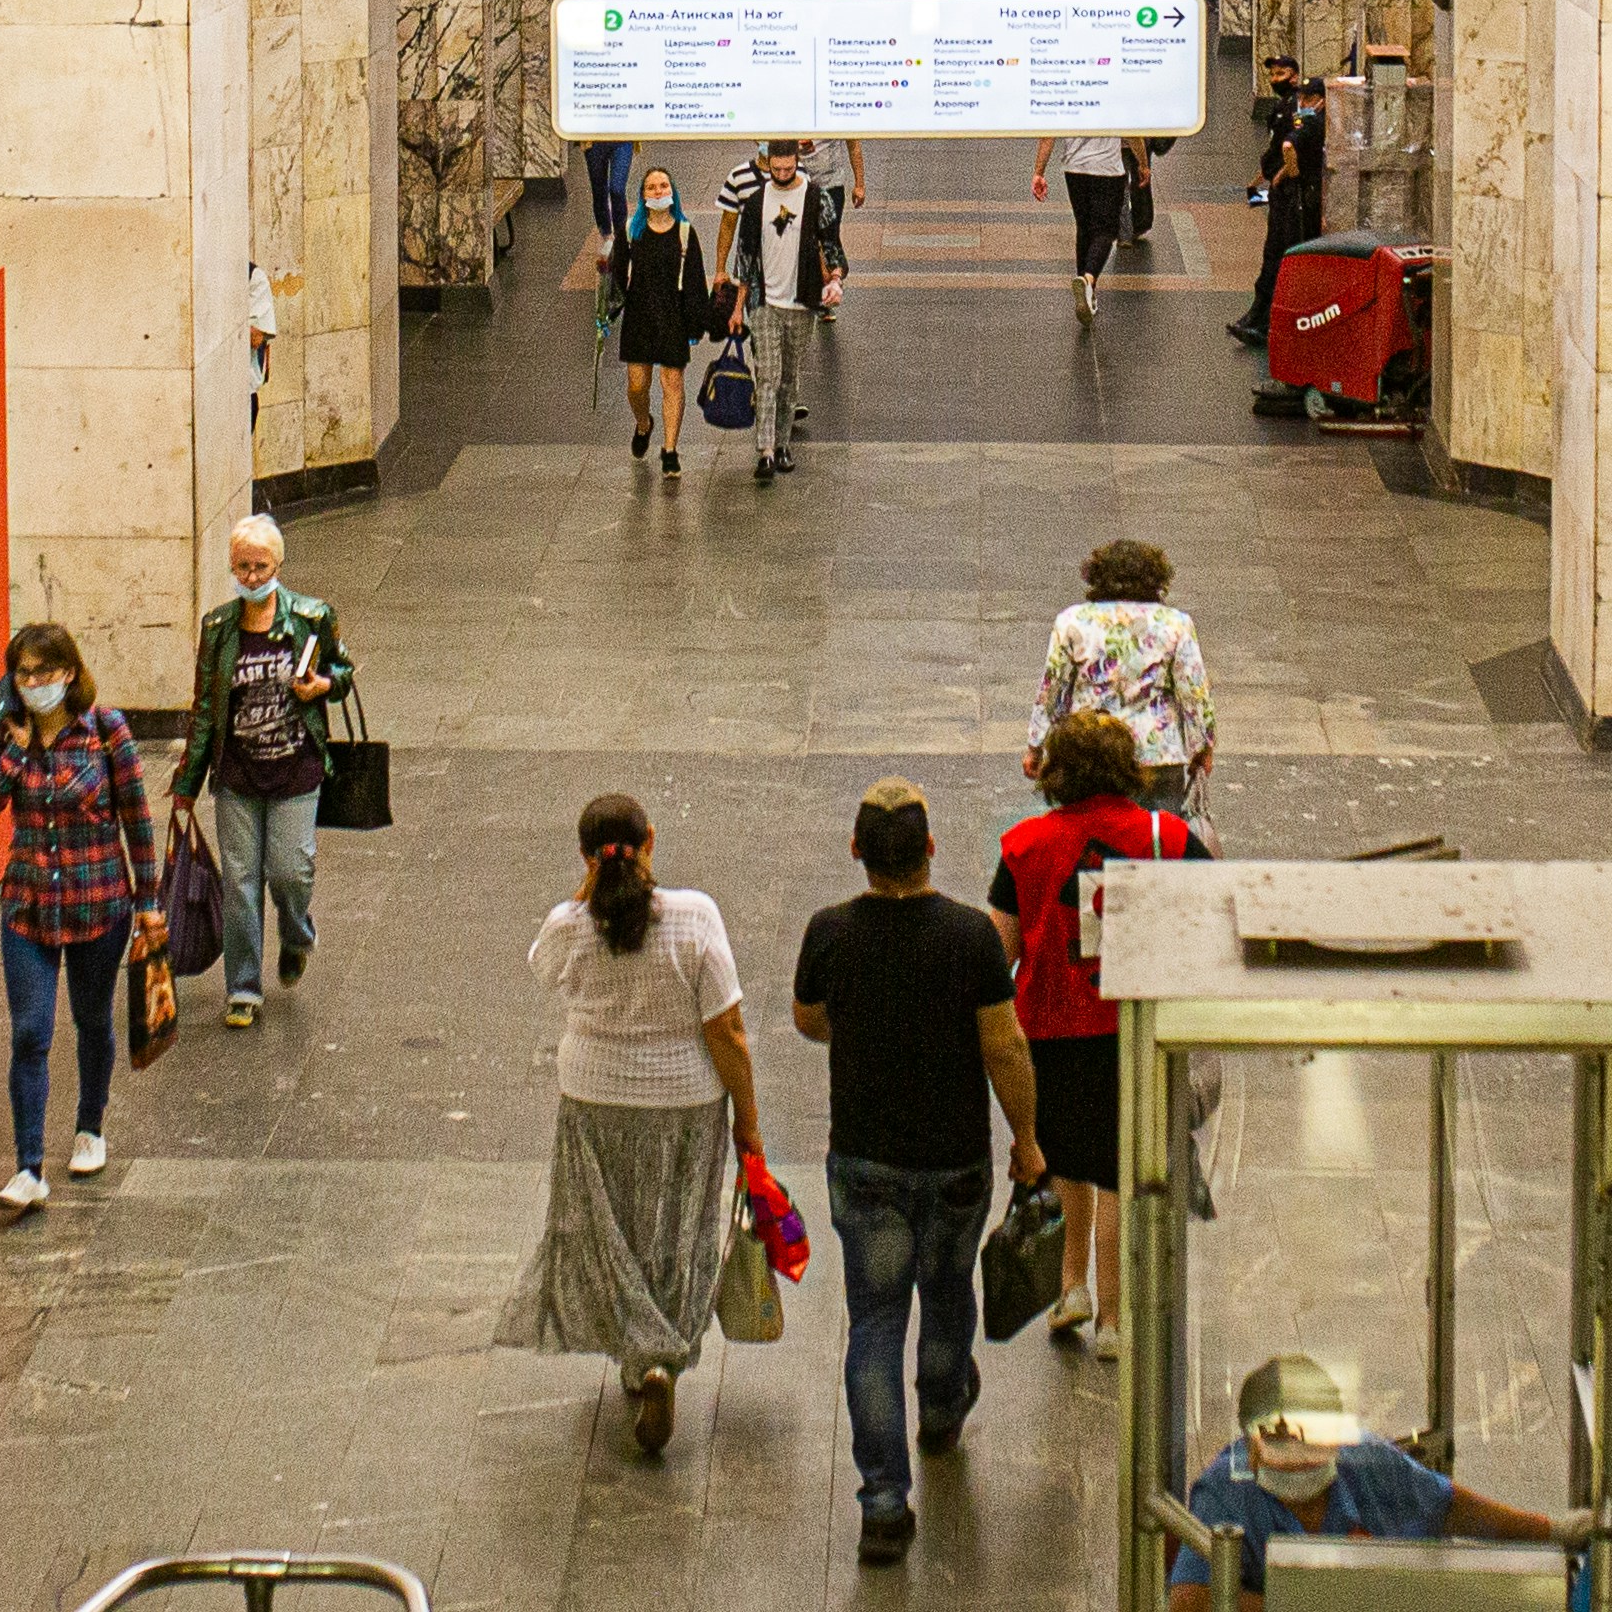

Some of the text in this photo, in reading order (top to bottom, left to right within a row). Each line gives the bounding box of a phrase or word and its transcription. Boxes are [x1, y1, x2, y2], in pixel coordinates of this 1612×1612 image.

[629, 9, 734, 21] Алма-Атинская
[745, 9, 763, 20] На
[767, 10, 783, 20] юг
[1000, 7, 1017, 18] На
[1021, 9, 1061, 20] север
[1072, 7, 1131, 20] Ховрино
[573, 60, 638, 69] Коломенская
[664, 59, 707, 69] Орехово
[573, 81, 628, 91] Каширская
[829, 100, 873, 110] Тверская
[933, 99, 980, 109] Аэропорт
